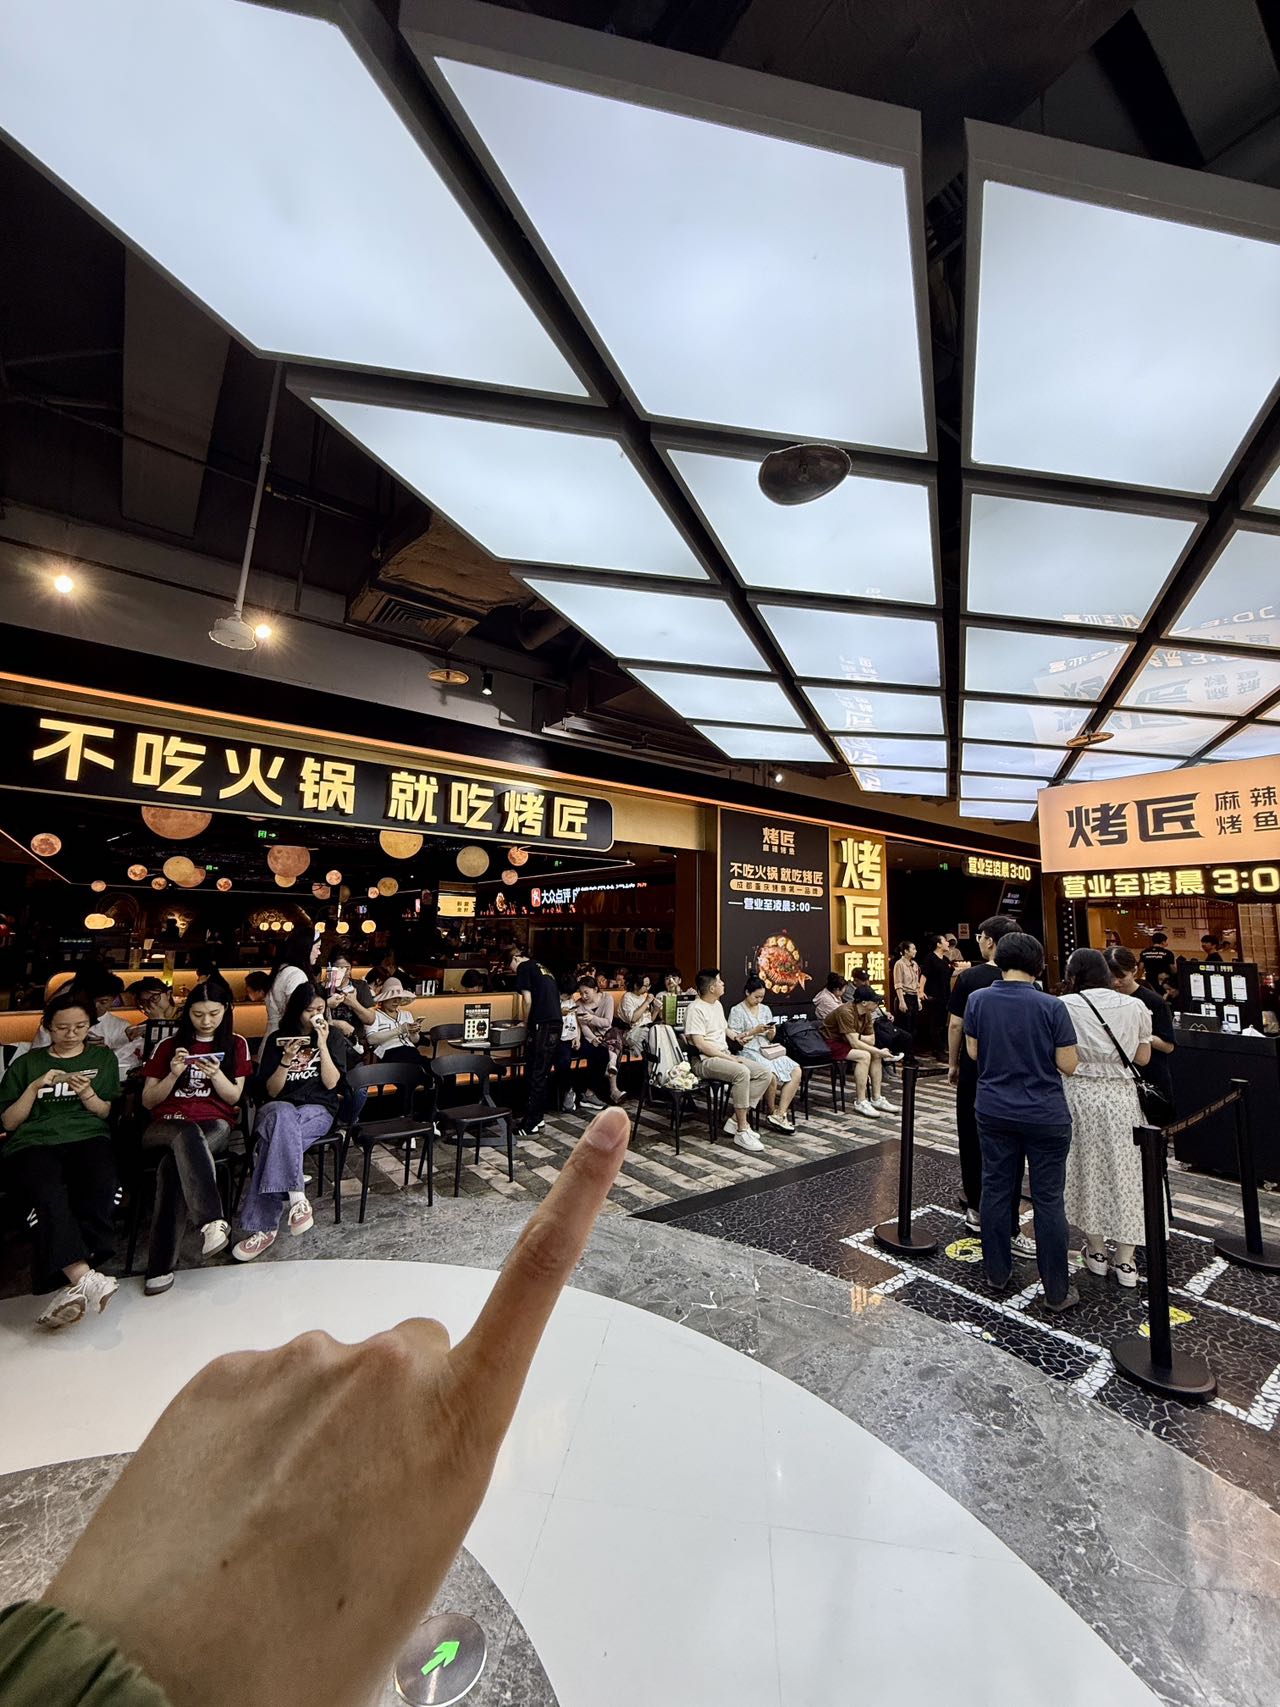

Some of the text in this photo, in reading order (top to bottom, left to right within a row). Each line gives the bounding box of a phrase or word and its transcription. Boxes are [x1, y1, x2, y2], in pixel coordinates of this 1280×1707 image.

[32, 717, 589, 841] 不吃火锅 就吃烤匠
[1215, 786, 1278, 812] 麻辣
[1065, 792, 1206, 848] 烤匠
[1216, 811, 1280, 835] 烤鱼
[762, 827, 795, 846] 烤匠
[729, 862, 824, 885] 不吃火锅 就吃烤匠
[541, 888, 571, 904] 大众点评
[743, 897, 811, 913] 营业至凌晨3:00
[37, 1082, 77, 1099] FIL
